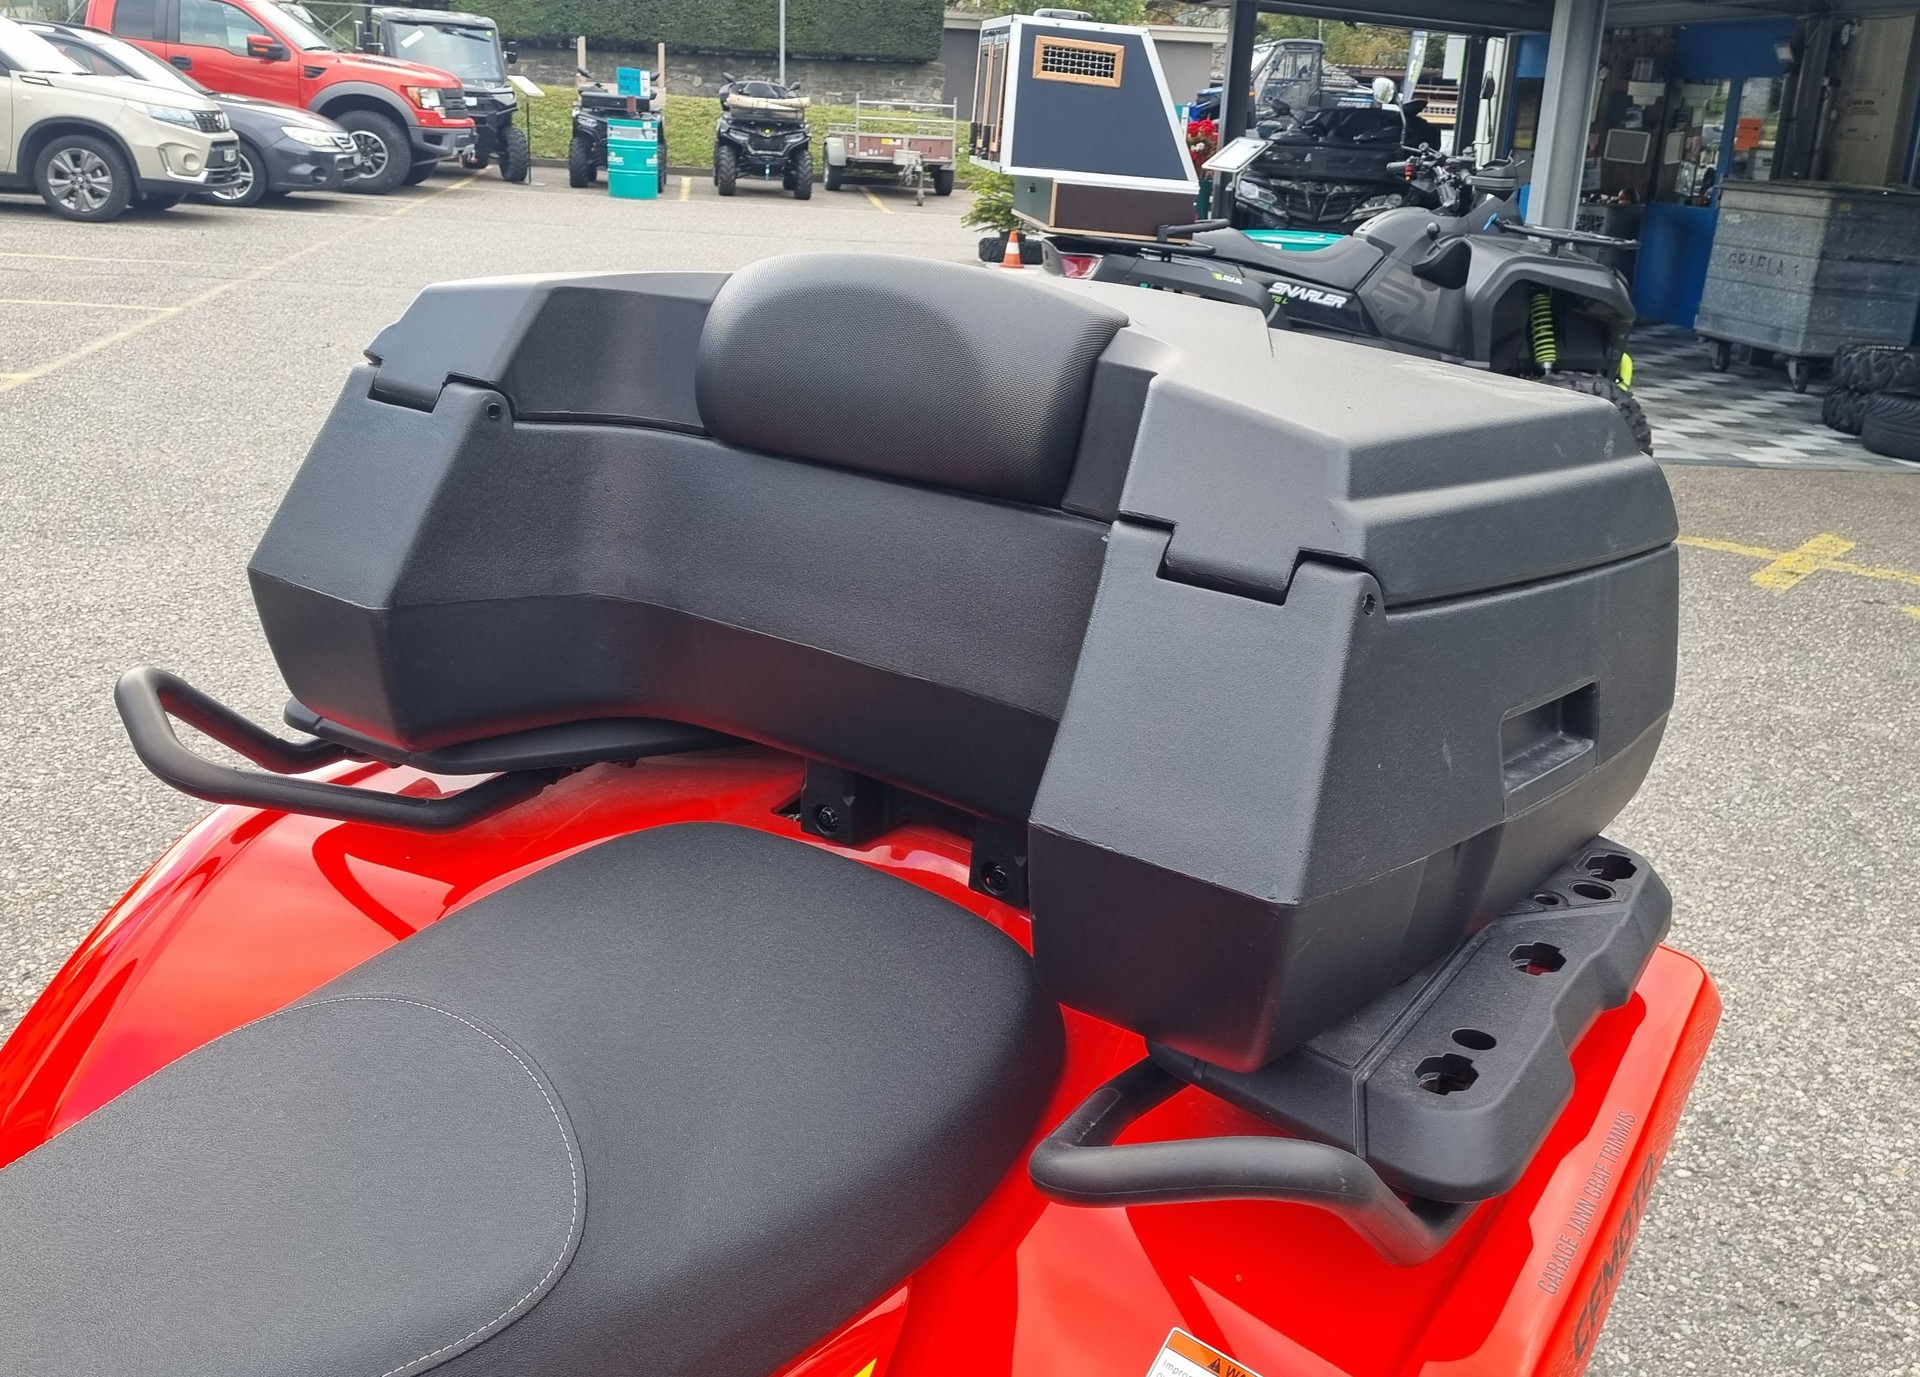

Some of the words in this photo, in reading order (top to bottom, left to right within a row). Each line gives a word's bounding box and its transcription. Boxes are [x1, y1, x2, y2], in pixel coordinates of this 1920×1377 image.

[1268, 281, 1348, 309] SNARLER
[1537, 1233, 1580, 1296] GARAGE
[1566, 1197, 1597, 1238] JANN
[1583, 1163, 1612, 1201] GRAF
[1600, 1110, 1637, 1164] TRIMMIS
[1574, 1152, 1654, 1361] CFMOTO
